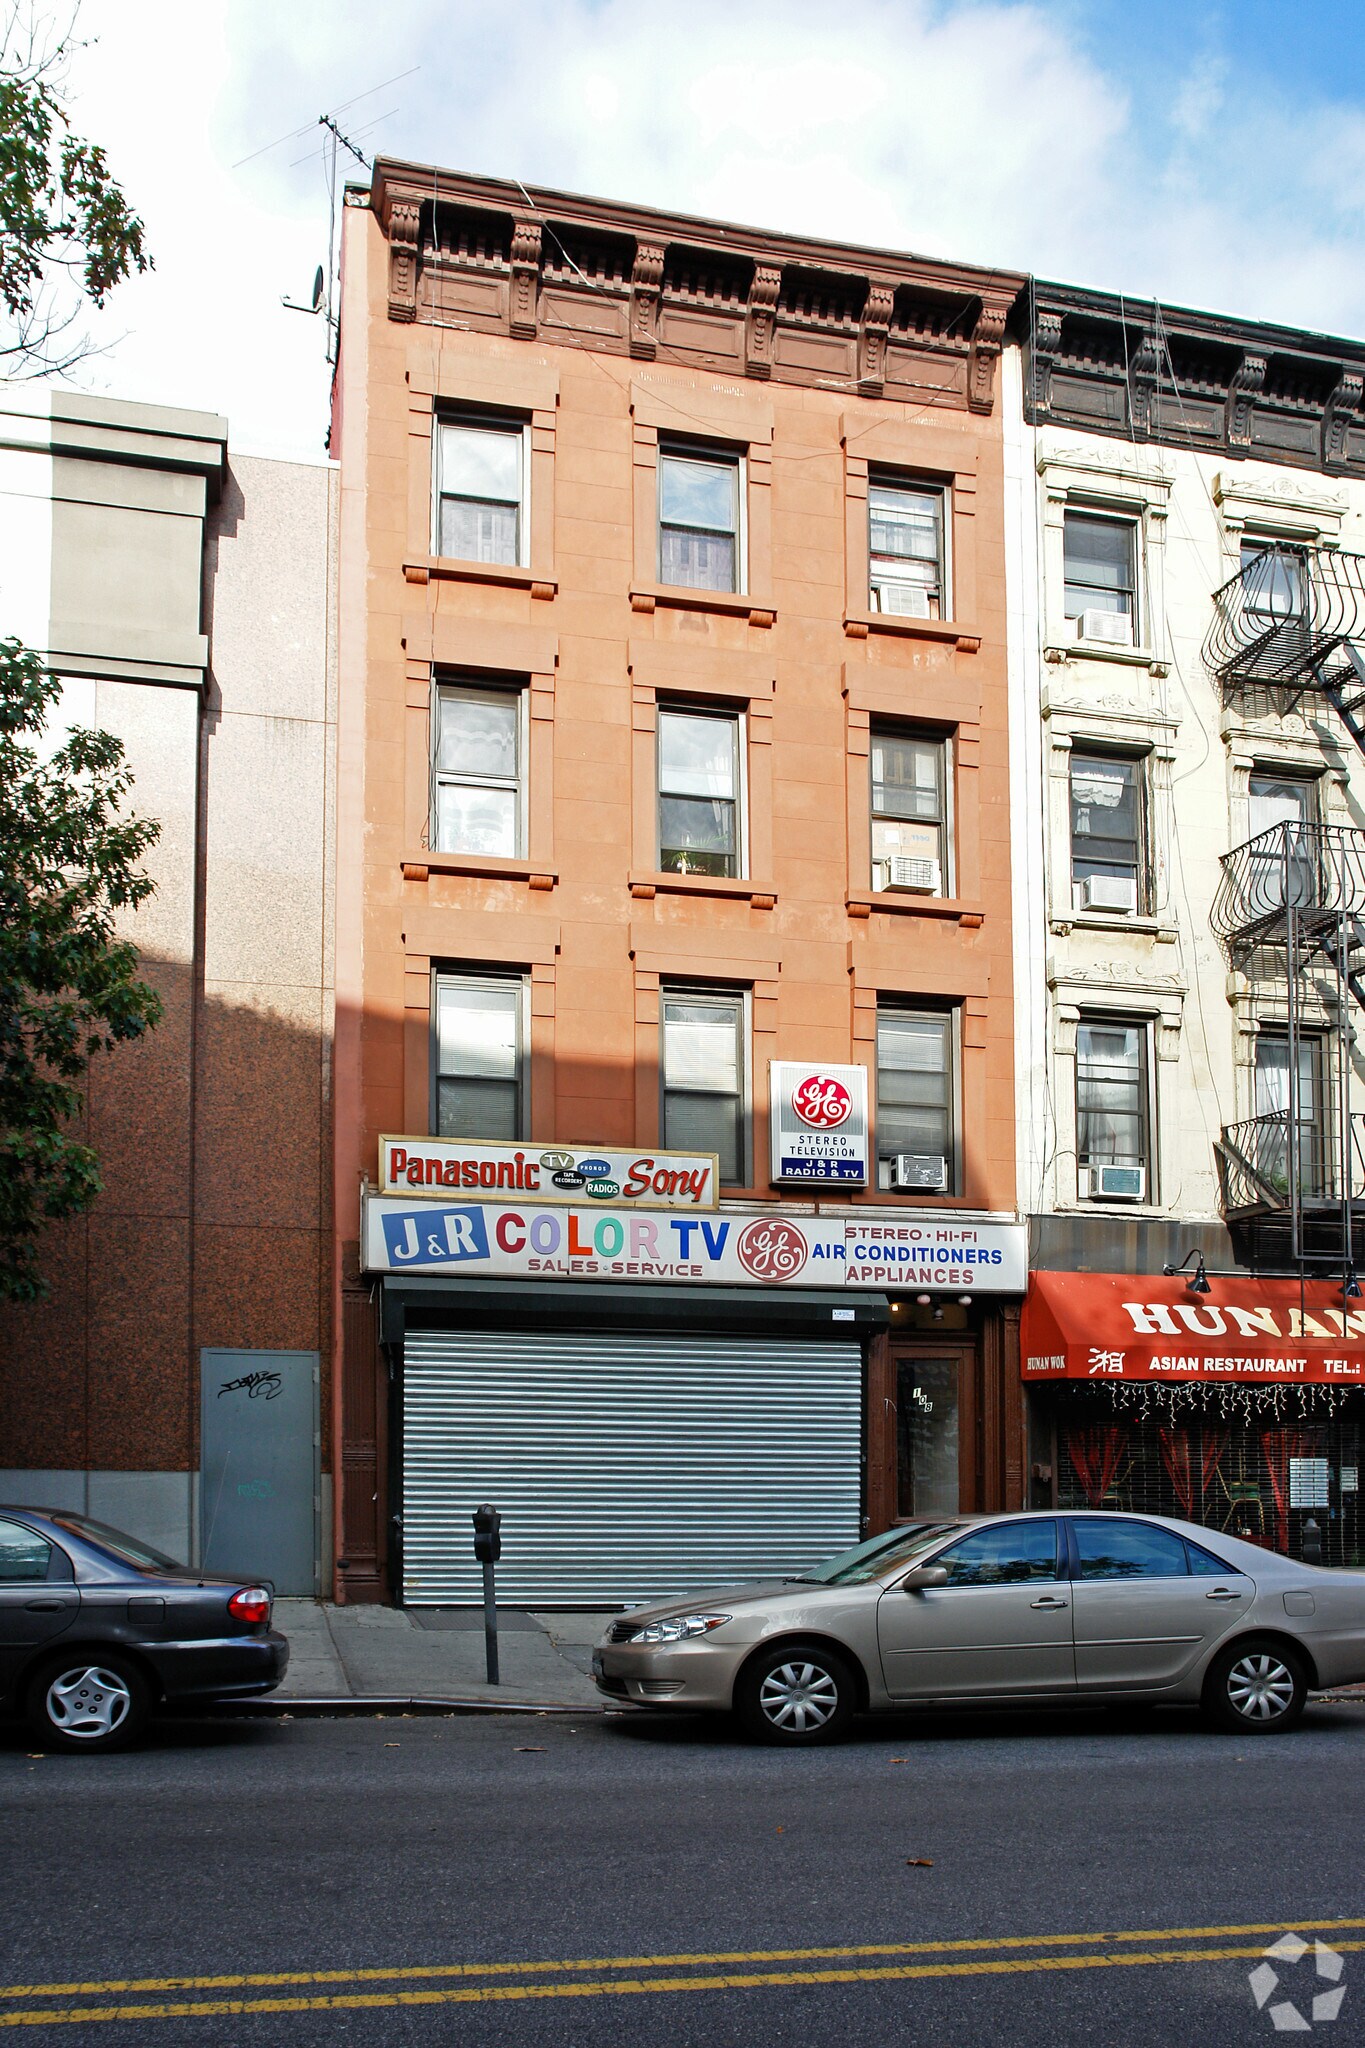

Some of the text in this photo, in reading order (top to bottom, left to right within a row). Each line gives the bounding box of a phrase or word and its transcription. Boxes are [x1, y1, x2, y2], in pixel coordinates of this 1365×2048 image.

[799, 1135, 847, 1145] STEREO
[790, 1145, 855, 1157] TELEVISION
[390, 1148, 540, 1190] Panasonic
[545, 1154, 570, 1167] TV
[805, 1159, 838, 1168] J & R
[623, 1158, 711, 1202] Sony
[785, 1167, 859, 1178] RADIO & TV
[587, 1183, 619, 1194] RADIOS
[496, 1213, 730, 1260] COLOR TV
[845, 1226, 978, 1243] STEREO HI-FI
[812, 1243, 1003, 1265] AIR CONDITIONERS
[528, 1258, 703, 1277] SALES SERVICE
[846, 1265, 975, 1285] APPLIANCES
[1121, 1302, 1365, 1340] HUNAN
[1027, 1355, 1066, 1371] HUNAN WOK
[1088, 1347, 1126, 1375] 湘
[1149, 1356, 1360, 1374] ASIAN RESTAURANT TEL.:
[914, 1388, 932, 1411] 108
